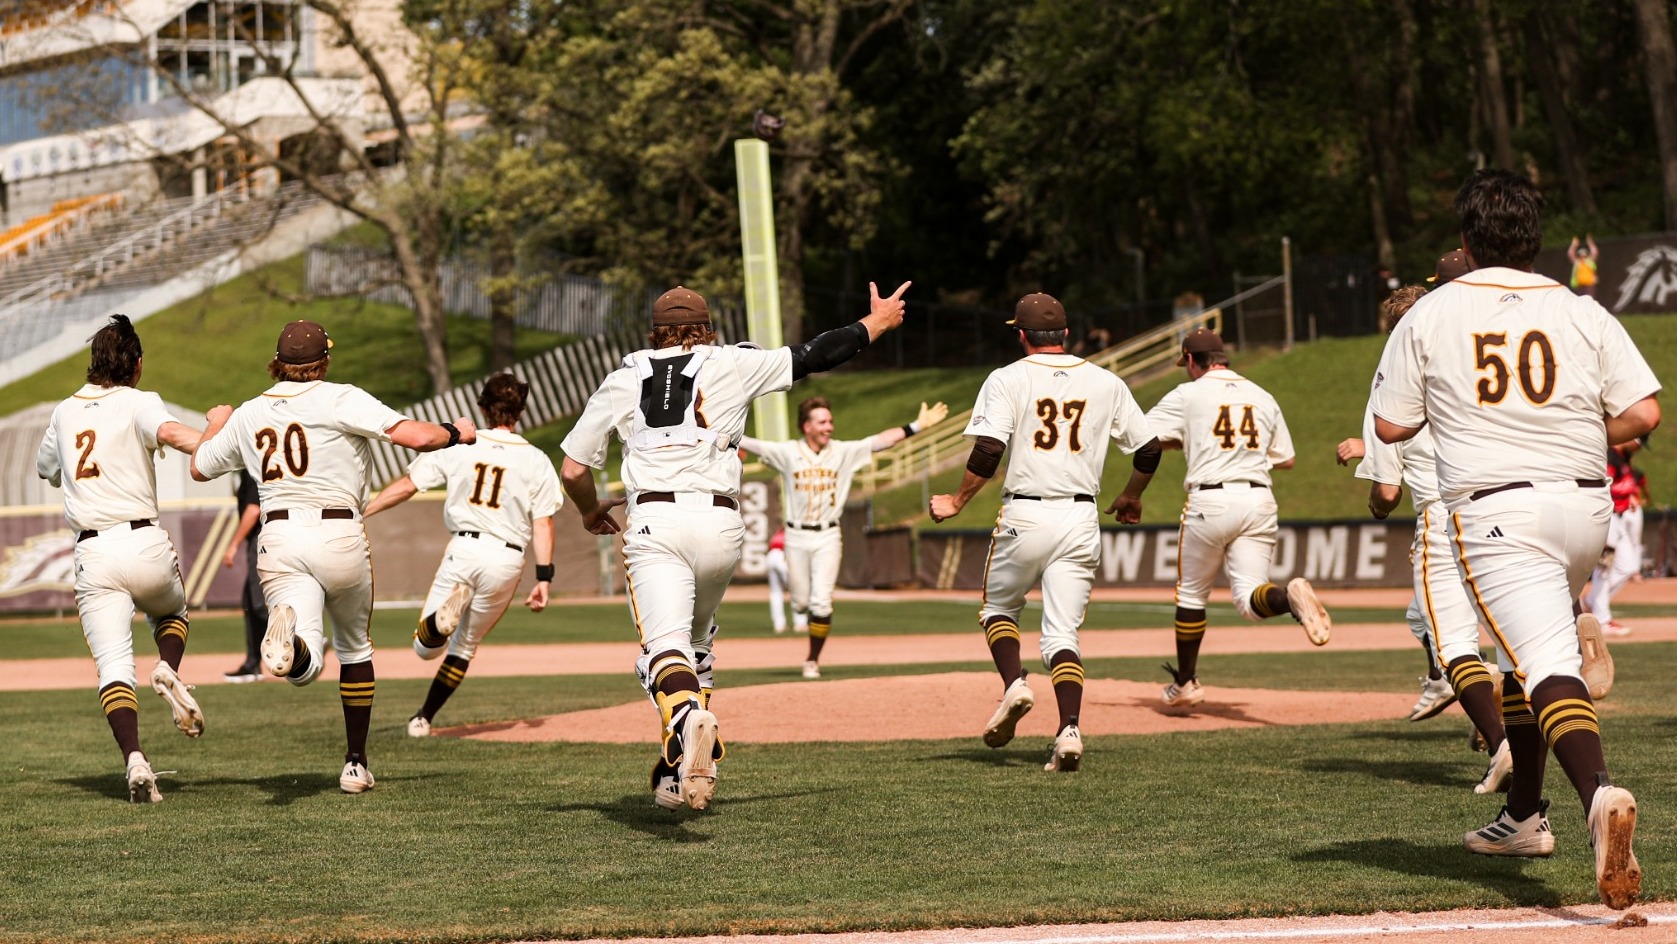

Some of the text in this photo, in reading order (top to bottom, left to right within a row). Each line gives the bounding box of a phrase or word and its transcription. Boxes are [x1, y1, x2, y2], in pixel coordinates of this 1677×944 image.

[663, 364, 673, 410] EVOSHIELD
[1471, 328, 1559, 407] 50
[255, 422, 309, 484] 20
[1034, 397, 1087, 453] 37
[1212, 404, 1259, 450] 44
[75, 428, 100, 481] 2
[468, 462, 507, 511] 11
[741, 481, 768, 576] 335
[1101, 523, 1387, 581] WEOME
